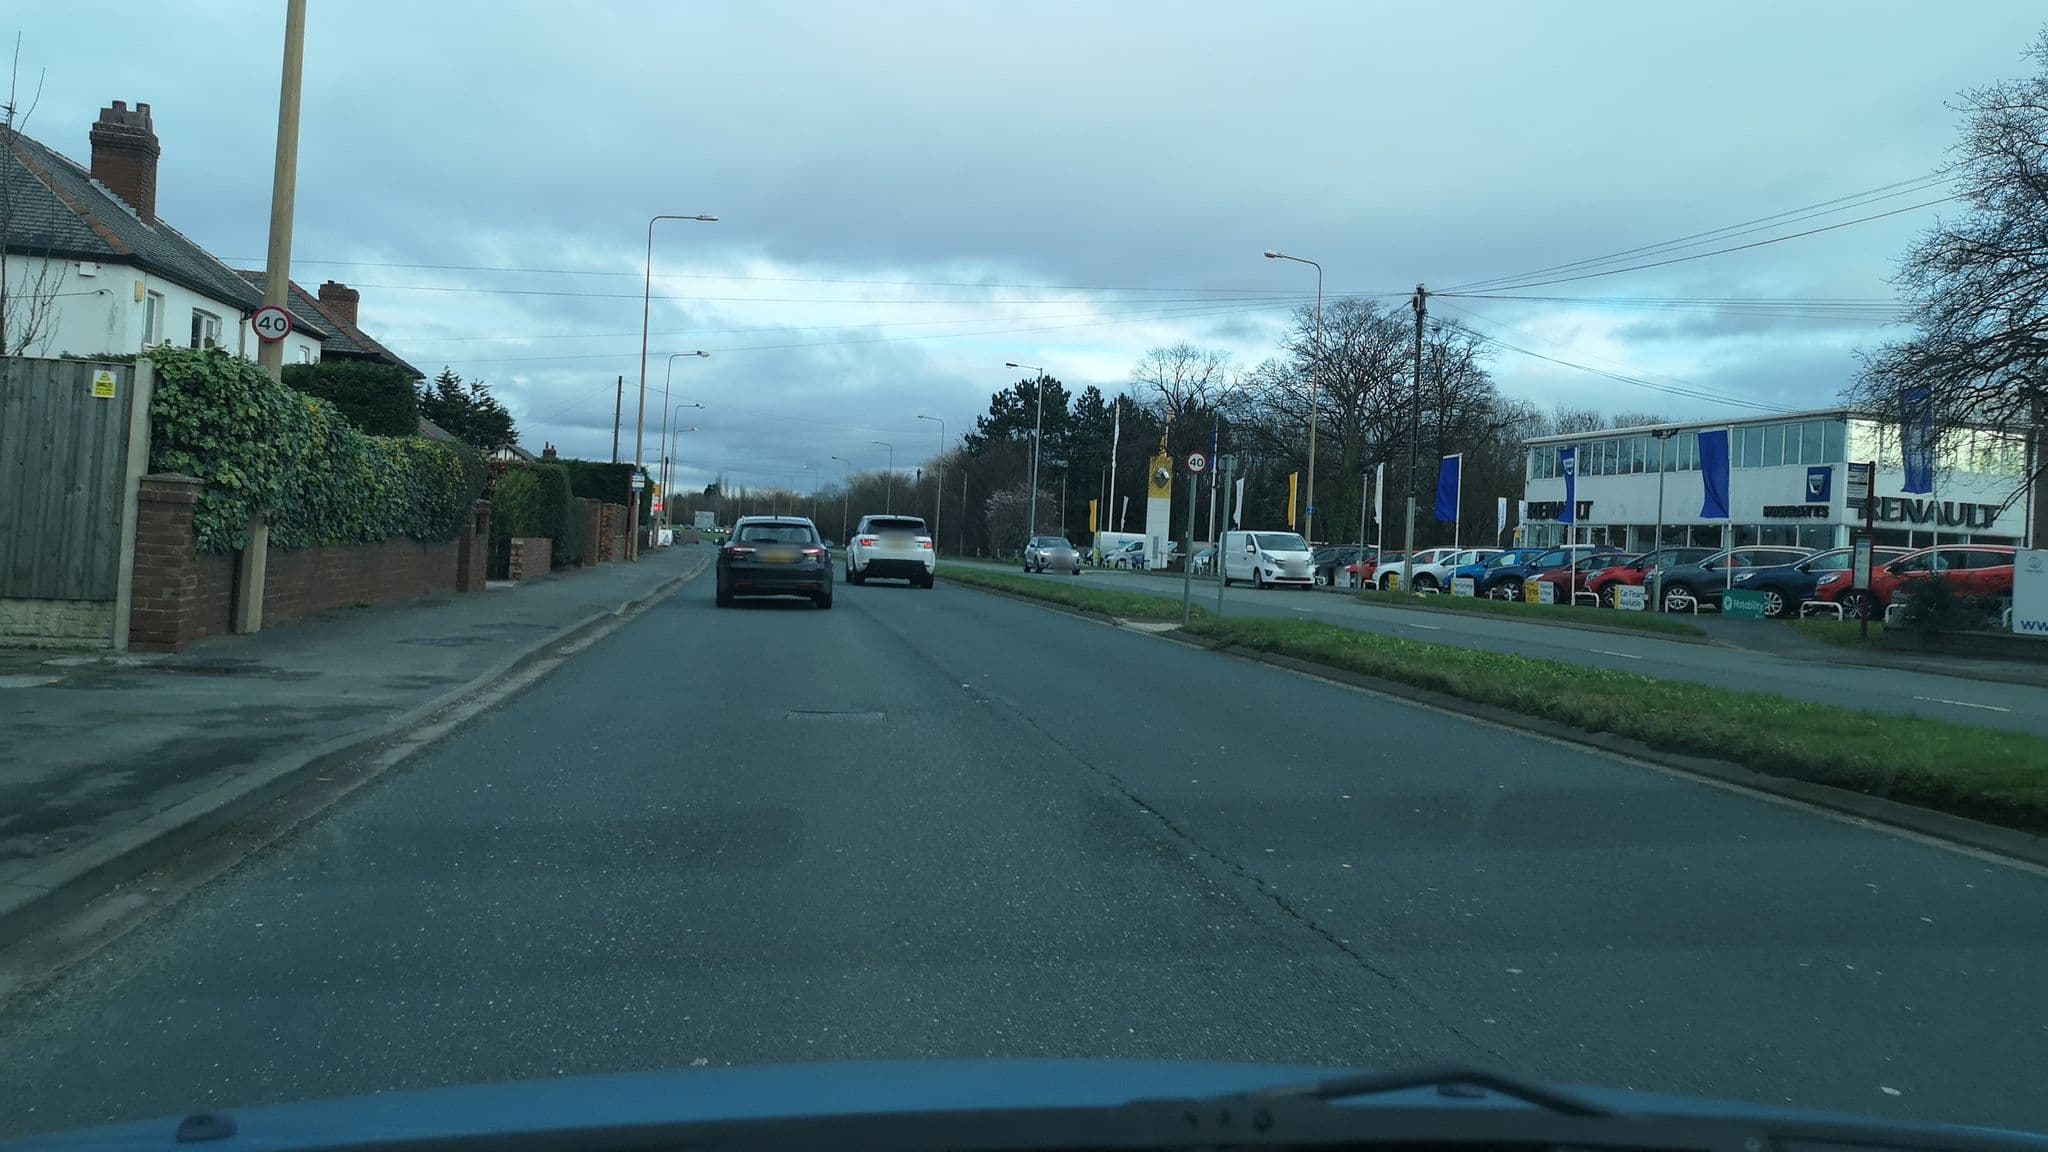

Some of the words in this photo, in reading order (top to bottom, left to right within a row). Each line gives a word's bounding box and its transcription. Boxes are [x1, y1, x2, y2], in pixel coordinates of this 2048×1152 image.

[258, 316, 286, 331] 40
[1190, 458, 1204, 467] 40
[1858, 496, 2001, 528] RENAULT
[1733, 599, 1763, 613] Motability
